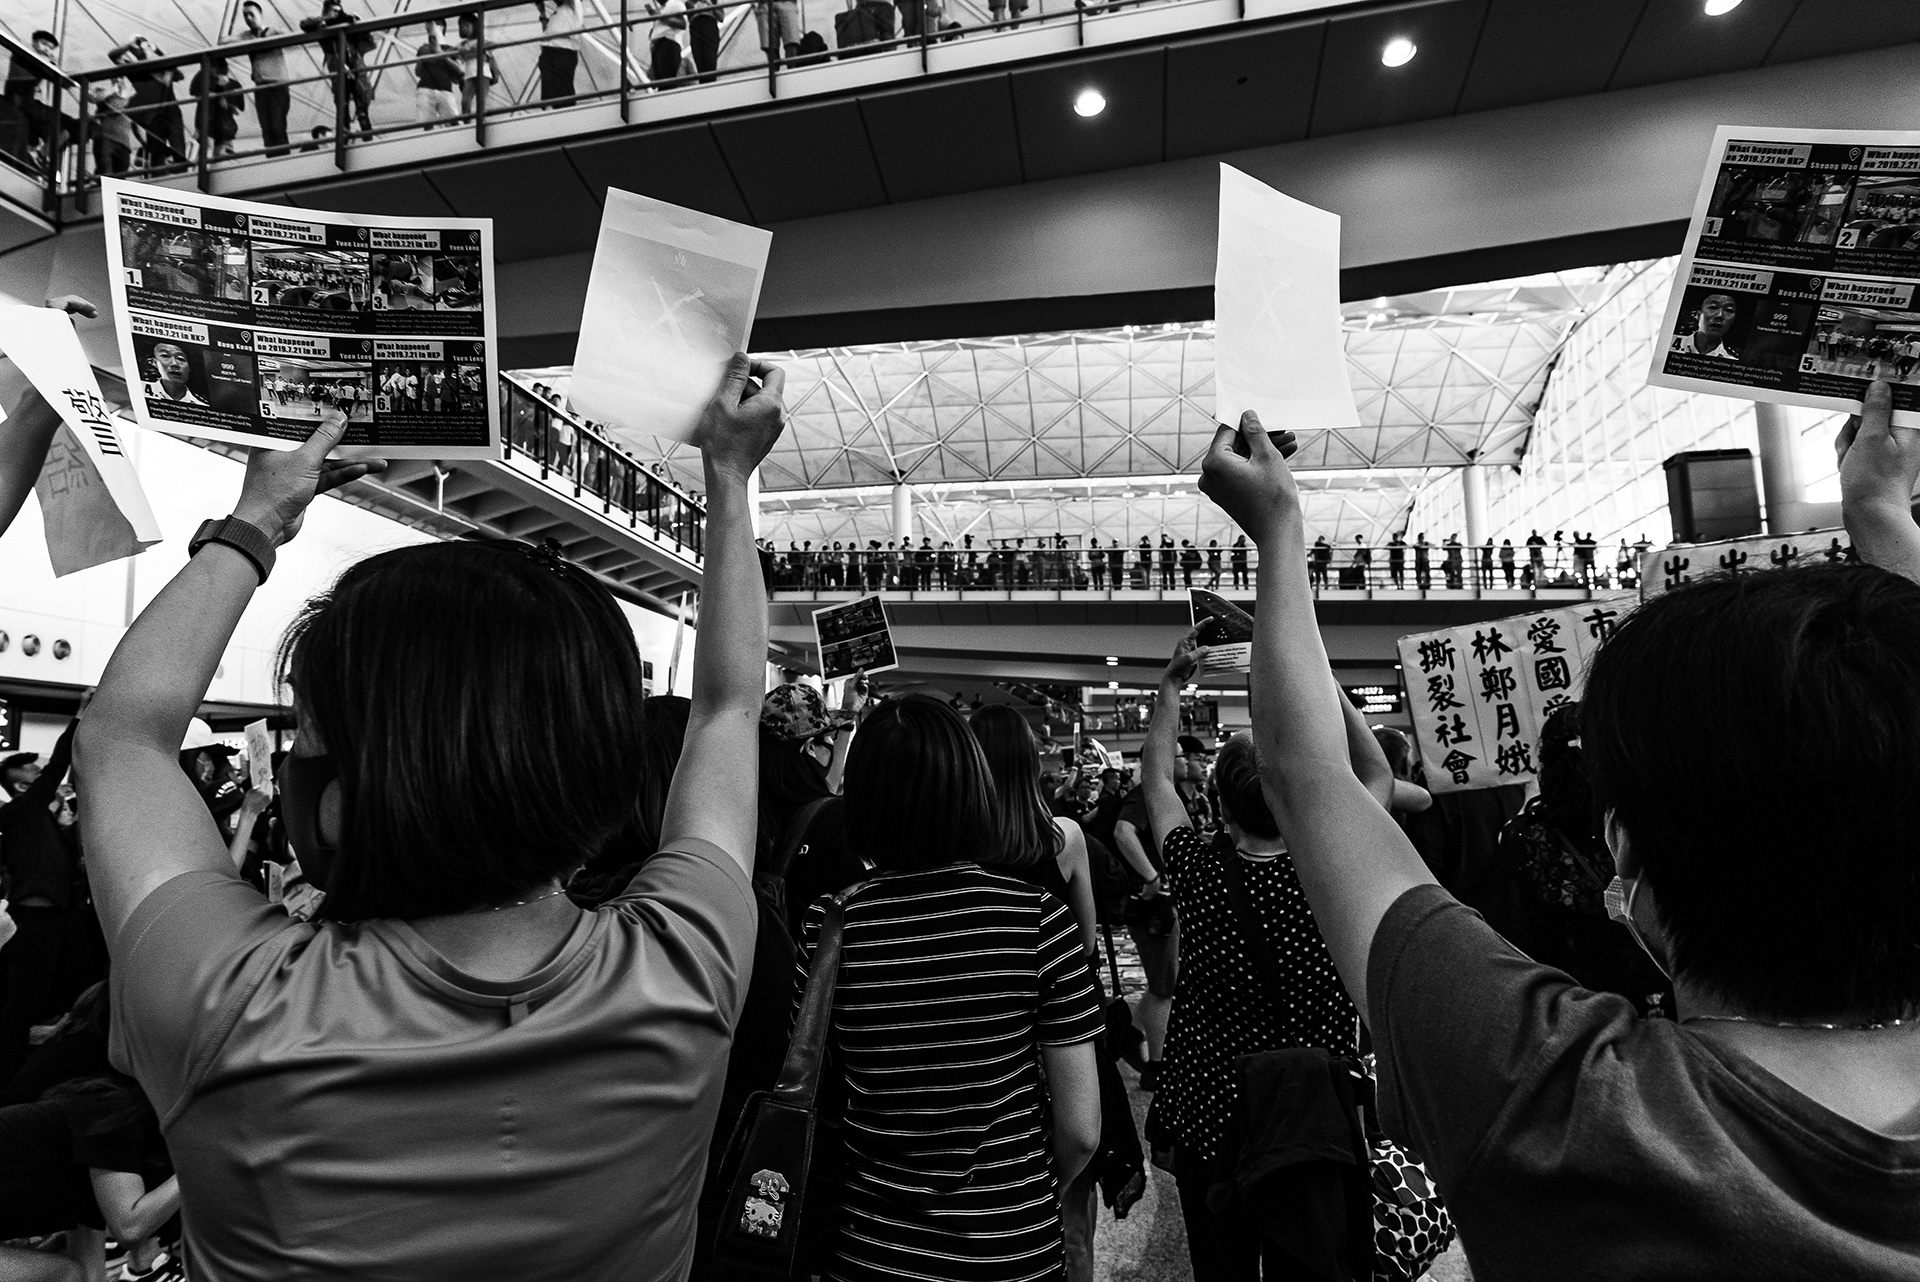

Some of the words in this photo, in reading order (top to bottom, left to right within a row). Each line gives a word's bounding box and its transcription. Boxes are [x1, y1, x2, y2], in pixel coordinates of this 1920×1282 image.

[1751, 146, 1794, 155] happened
[1866, 150, 1890, 158] What
[1737, 154, 1775, 162] 2019.7.21
[1876, 160, 1917, 169] 2019.7.21
[120, 197, 142, 207] What
[144, 201, 184, 215] happened
[133, 208, 169, 220] 2019.7.21
[182, 216, 197, 225] HK?
[251, 219, 271, 227] What
[273, 222, 310, 233] happened
[1707, 220, 1718, 234] 1.
[263, 229, 296, 238] 2019.7.21
[1839, 232, 1854, 247] 2.
[126, 271, 140, 285] 1.
[1693, 267, 1715, 276] What
[1715, 270, 1756, 281] happened
[1702, 277, 1739, 287] 2019.7.21
[1749, 282, 1766, 290] HK?
[1826, 282, 1850, 290] What
[1850, 284, 1896, 295] happened
[254, 290, 268, 304] 2.
[374, 296, 387, 309] 3.
[1836, 292, 1875, 302] 2019.7.21
[1887, 296, 1906, 305] HK?
[131, 316, 152, 325] What
[154, 320, 192, 332] happened
[144, 326, 179, 338] 2019.7.21
[190, 333, 205, 341] HK?
[268, 344, 300, 353] 2019.7.21
[277, 337, 314, 347] happened
[1672, 338, 1685, 351] 4.
[1802, 357, 1816, 372] 5.
[145, 384, 158, 397] 4.
[262, 404, 276, 416] 5.
[377, 398, 390, 411] 6.
[1470, 627, 1538, 776] 林鄭月娥
[1417, 638, 1477, 784] 撕裂社會
